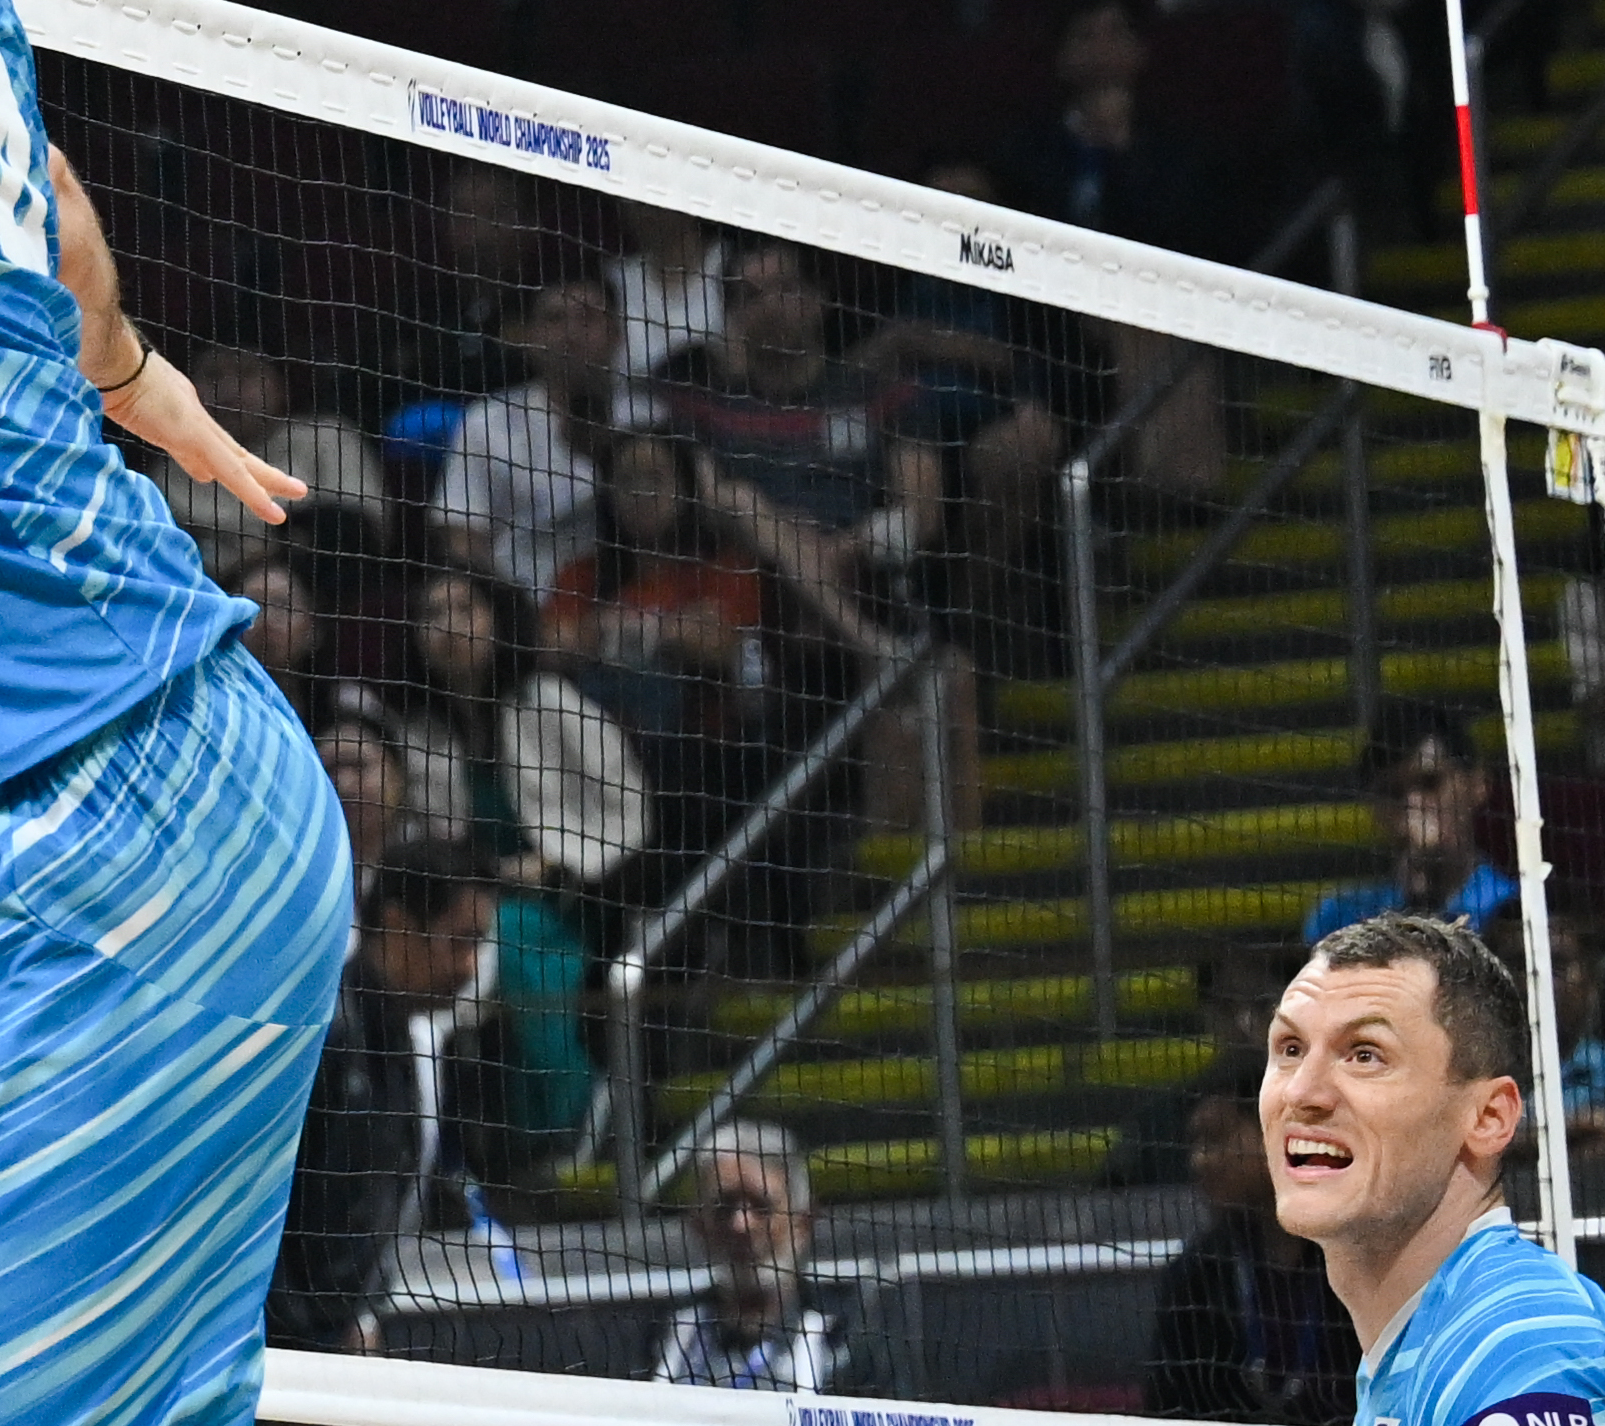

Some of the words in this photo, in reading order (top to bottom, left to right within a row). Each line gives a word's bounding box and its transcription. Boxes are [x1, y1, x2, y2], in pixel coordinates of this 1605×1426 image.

[417, 90, 474, 139] VOLLEYBALL
[476, 106, 512, 148] WORLD
[513, 115, 583, 165] CHAMPIONSHIP
